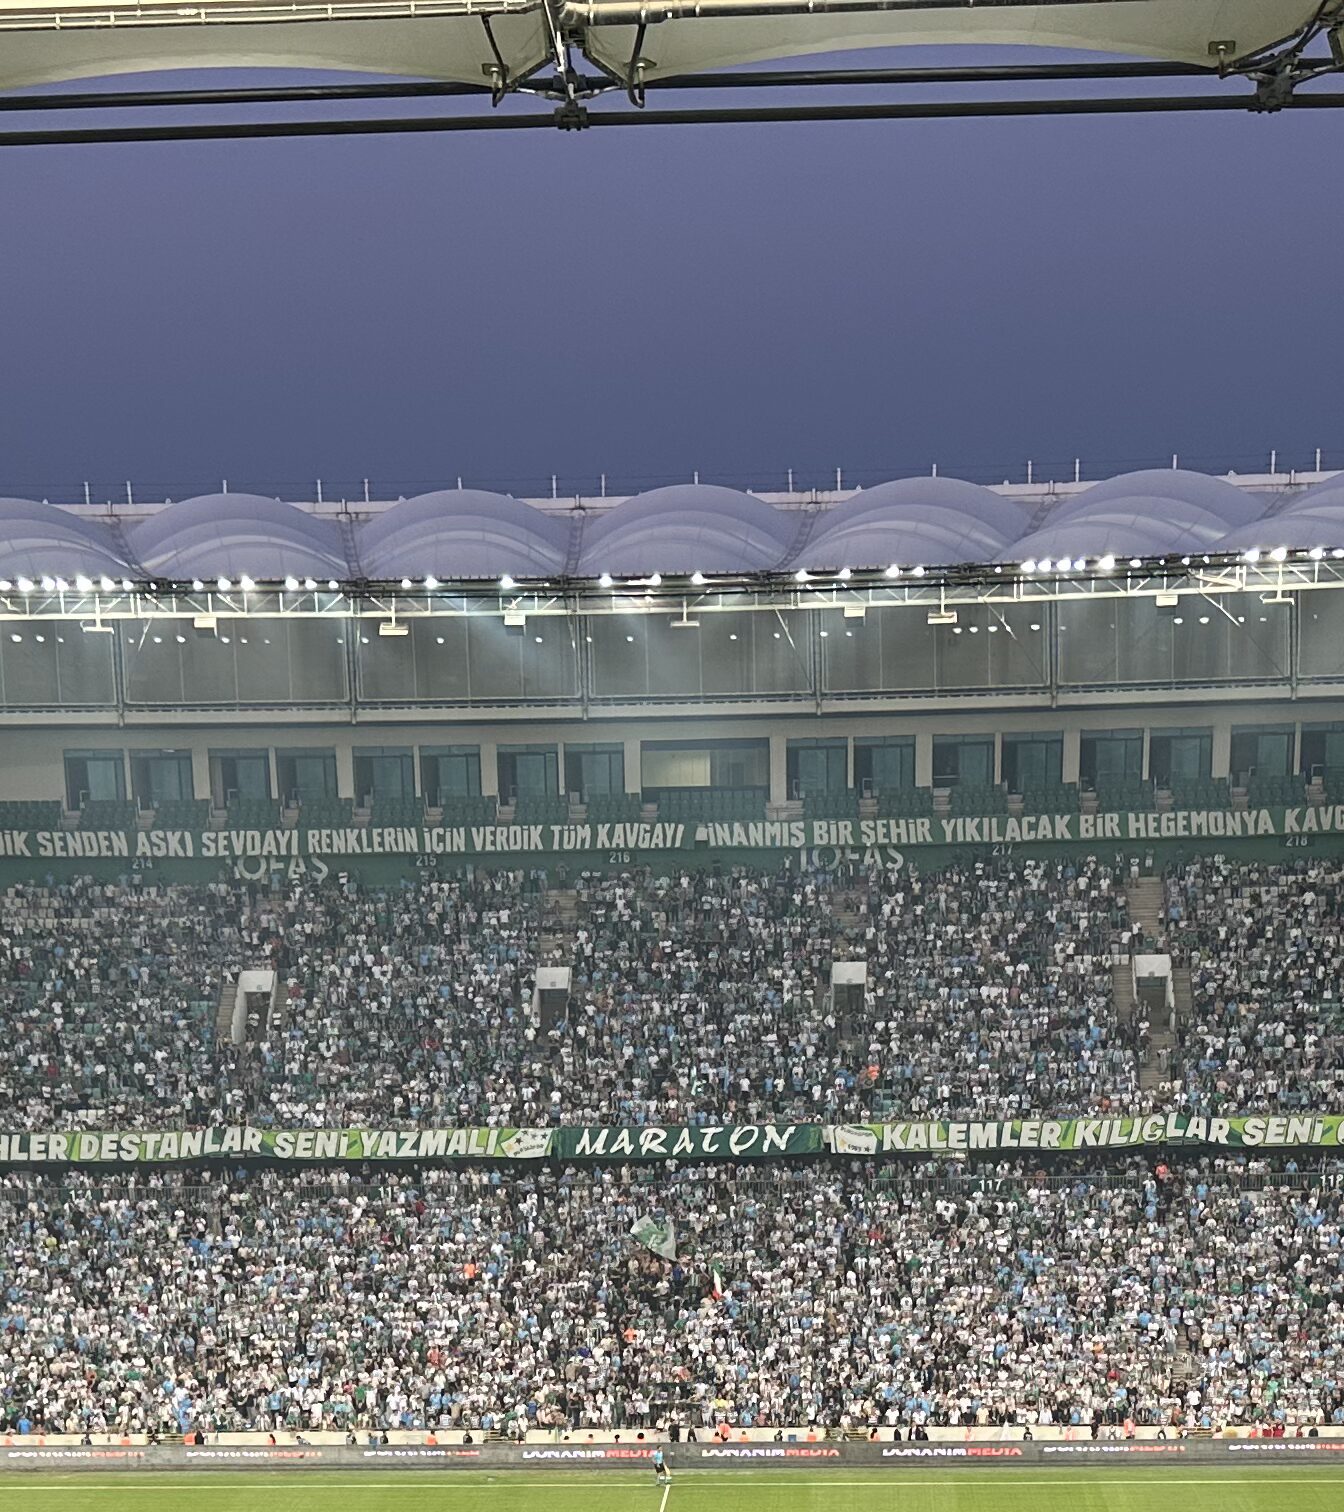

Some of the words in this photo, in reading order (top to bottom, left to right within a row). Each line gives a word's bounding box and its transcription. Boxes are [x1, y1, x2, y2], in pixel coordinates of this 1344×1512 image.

[813, 820, 854, 846] BİR
[941, 814, 1072, 843] YIKILACAK
[1080, 813, 1121, 839] BİR
[1128, 809, 1275, 838] HEGEMONYA
[38, 830, 128, 857] SENDEN
[201, 828, 300, 857] SEVDAYI
[551, 824, 591, 850] TÜM
[596, 823, 684, 849] KAVGAYI
[1286, 834, 1308, 847] 218
[132, 859, 154, 870] 214
[416, 855, 437, 867] 215
[609, 851, 631, 864] 216
[80, 1125, 262, 1162] DESTANLAR
[358, 1129, 499, 1157] YAZMALI
[574, 1125, 796, 1156] MARATON
[882, 1121, 1063, 1151] KALEMLER
[979, 1179, 1002, 1192] 117
